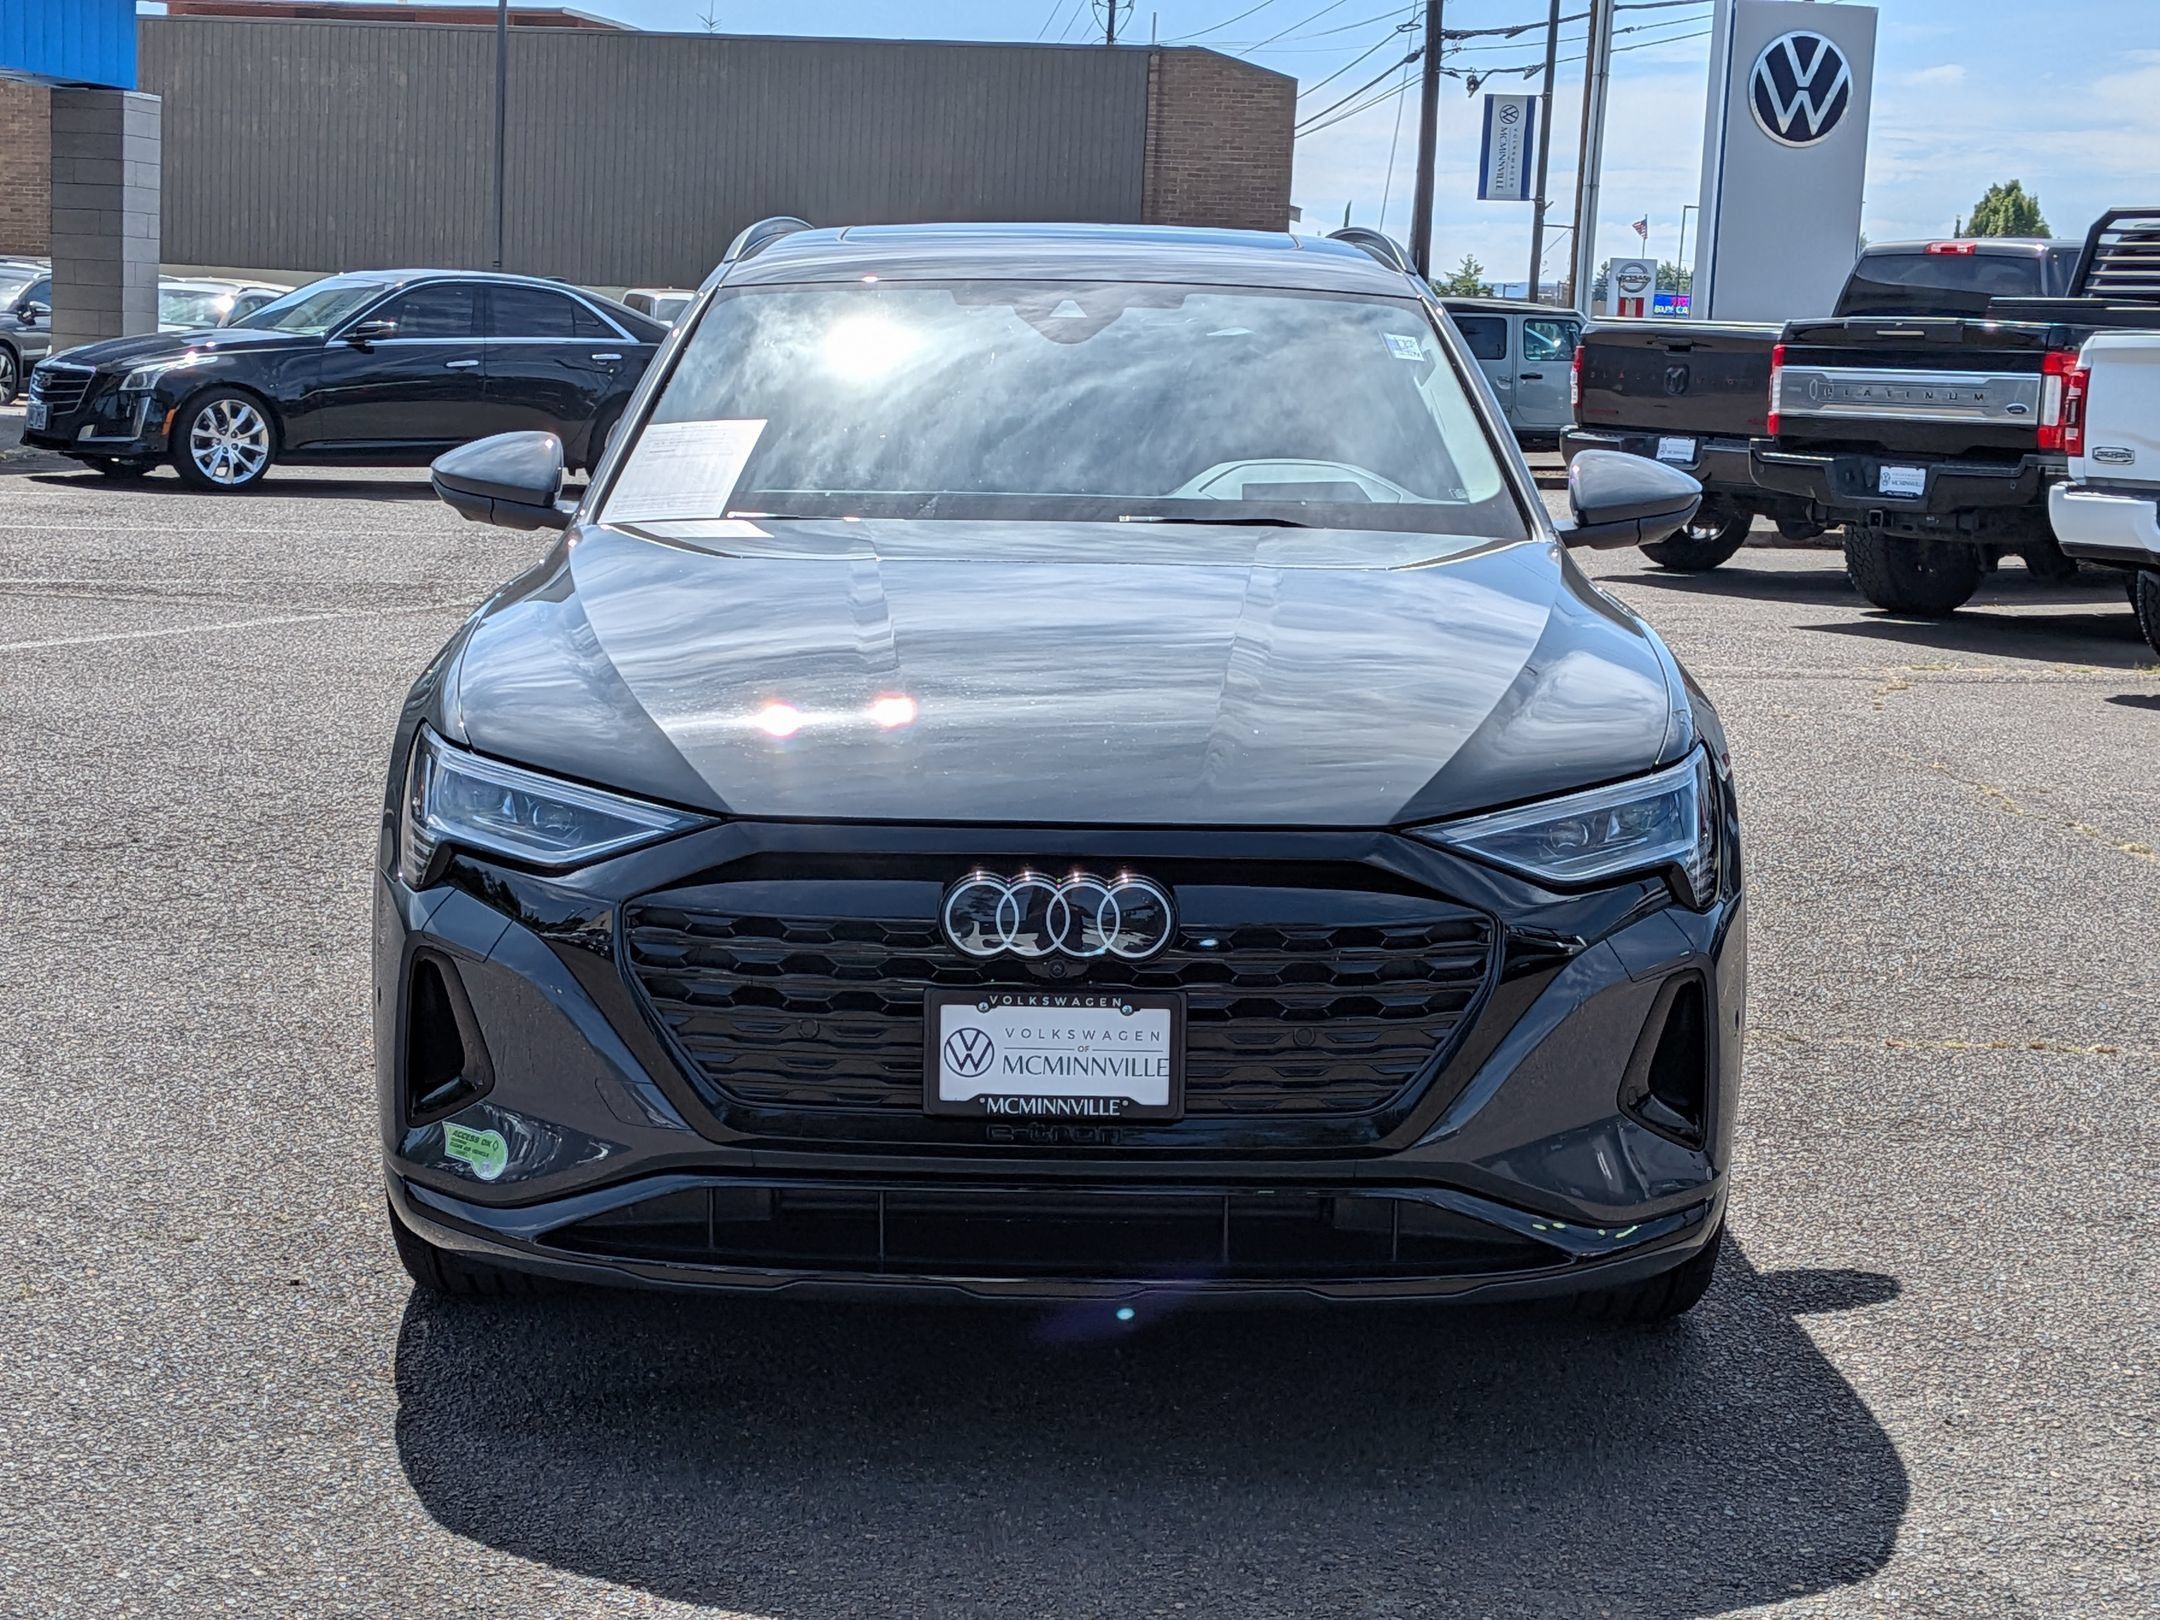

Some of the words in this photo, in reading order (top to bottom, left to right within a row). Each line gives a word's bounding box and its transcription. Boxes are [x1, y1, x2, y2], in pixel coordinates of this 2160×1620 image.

[1495, 126, 1508, 190] MCMINNVILLE
[1823, 386, 1985, 402] PLATINUM
[989, 995, 1122, 1008] VOLKSWAGEN
[1004, 1027, 1161, 1042] VOLKSWAGEN
[1077, 1045, 1090, 1053] OF
[1002, 1055, 1170, 1078] MCMINNVILLE
[986, 1097, 1121, 1116] MCMINNVILLE
[452, 1129, 480, 1143] ACCESS
[481, 1139, 493, 1148] OK
